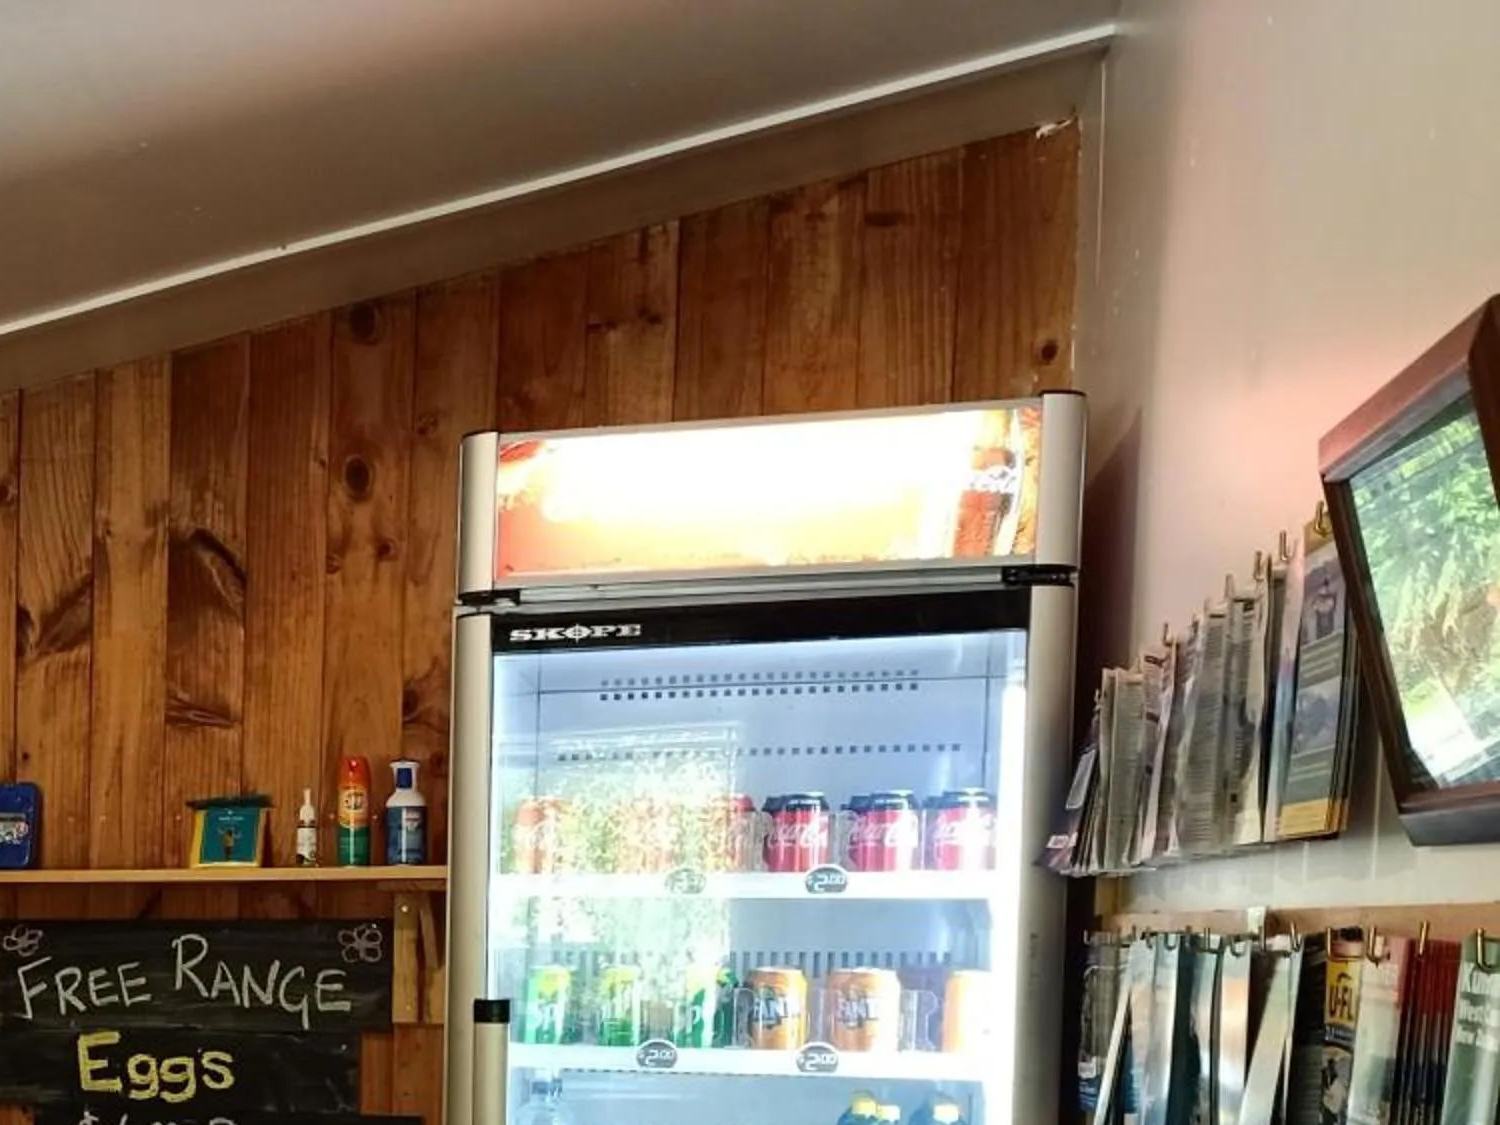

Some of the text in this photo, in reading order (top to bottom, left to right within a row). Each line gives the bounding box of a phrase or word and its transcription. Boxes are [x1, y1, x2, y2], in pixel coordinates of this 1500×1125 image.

[509, 622, 642, 645] SKOPE
[17, 934, 352, 1029] FREE RANGE
[77, 1031, 235, 1102] Eggs
